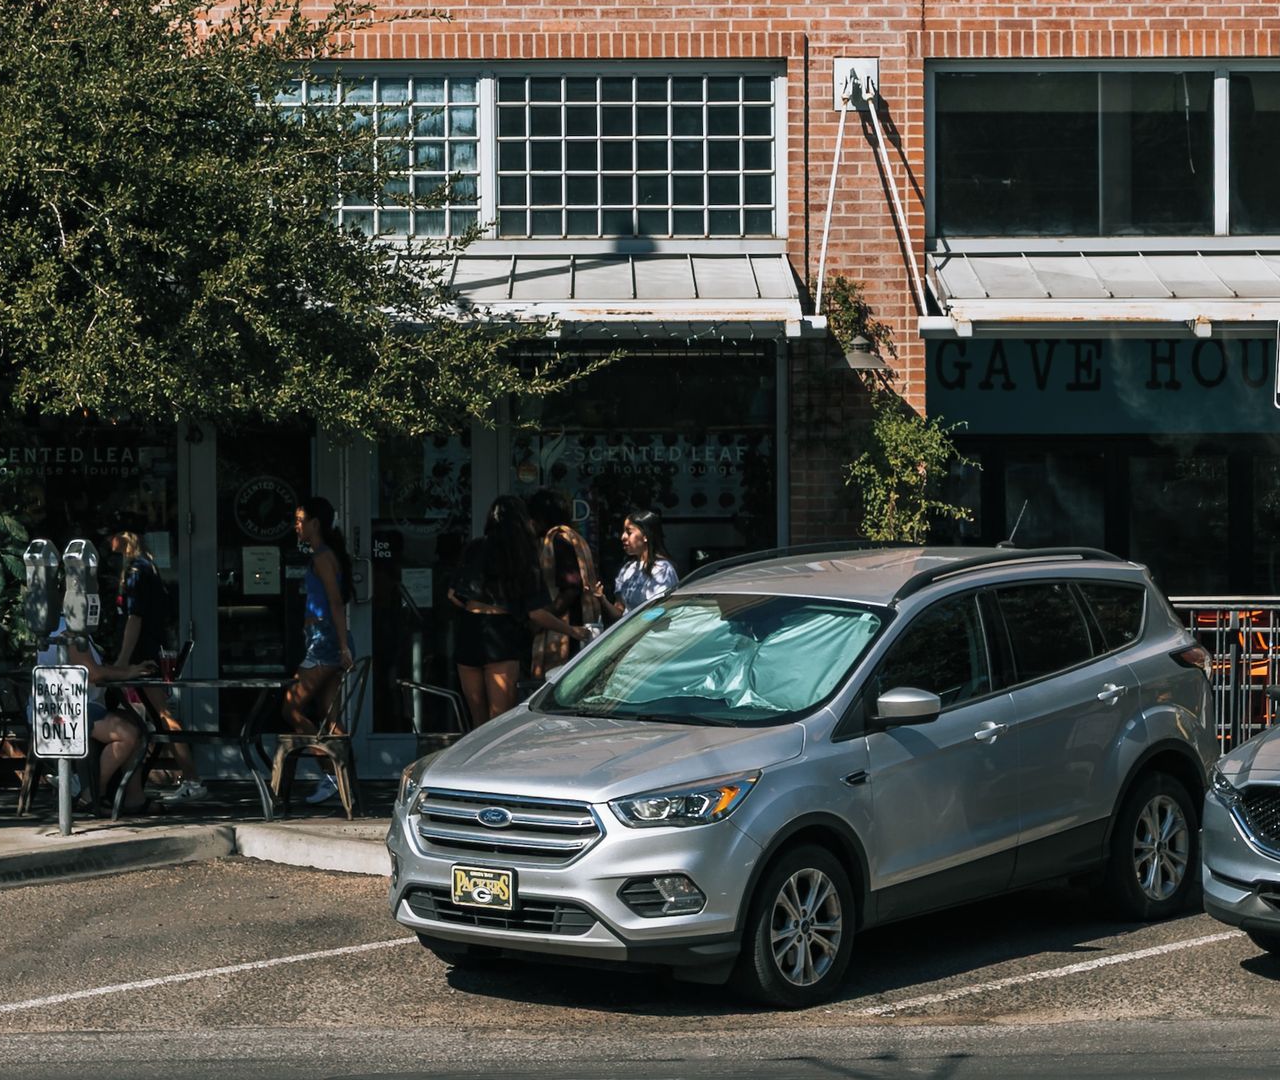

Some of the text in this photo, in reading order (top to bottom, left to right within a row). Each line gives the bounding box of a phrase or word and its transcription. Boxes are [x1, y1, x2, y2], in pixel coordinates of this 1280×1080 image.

[574, 446, 748, 462] SCENTED LEAF
[16, 464, 64, 477] house
[84, 464, 140, 480] lounge
[616, 462, 662, 475] house
[681, 462, 738, 477] lounge
[374, 539, 390, 550] Ice
[373, 548, 392, 558] Tea
[37, 683, 83, 696] BACK-IN
[38, 702, 82, 716] PARKING
[42, 721, 78, 740] ONLY
[454, 870, 509, 900] PACKERS
